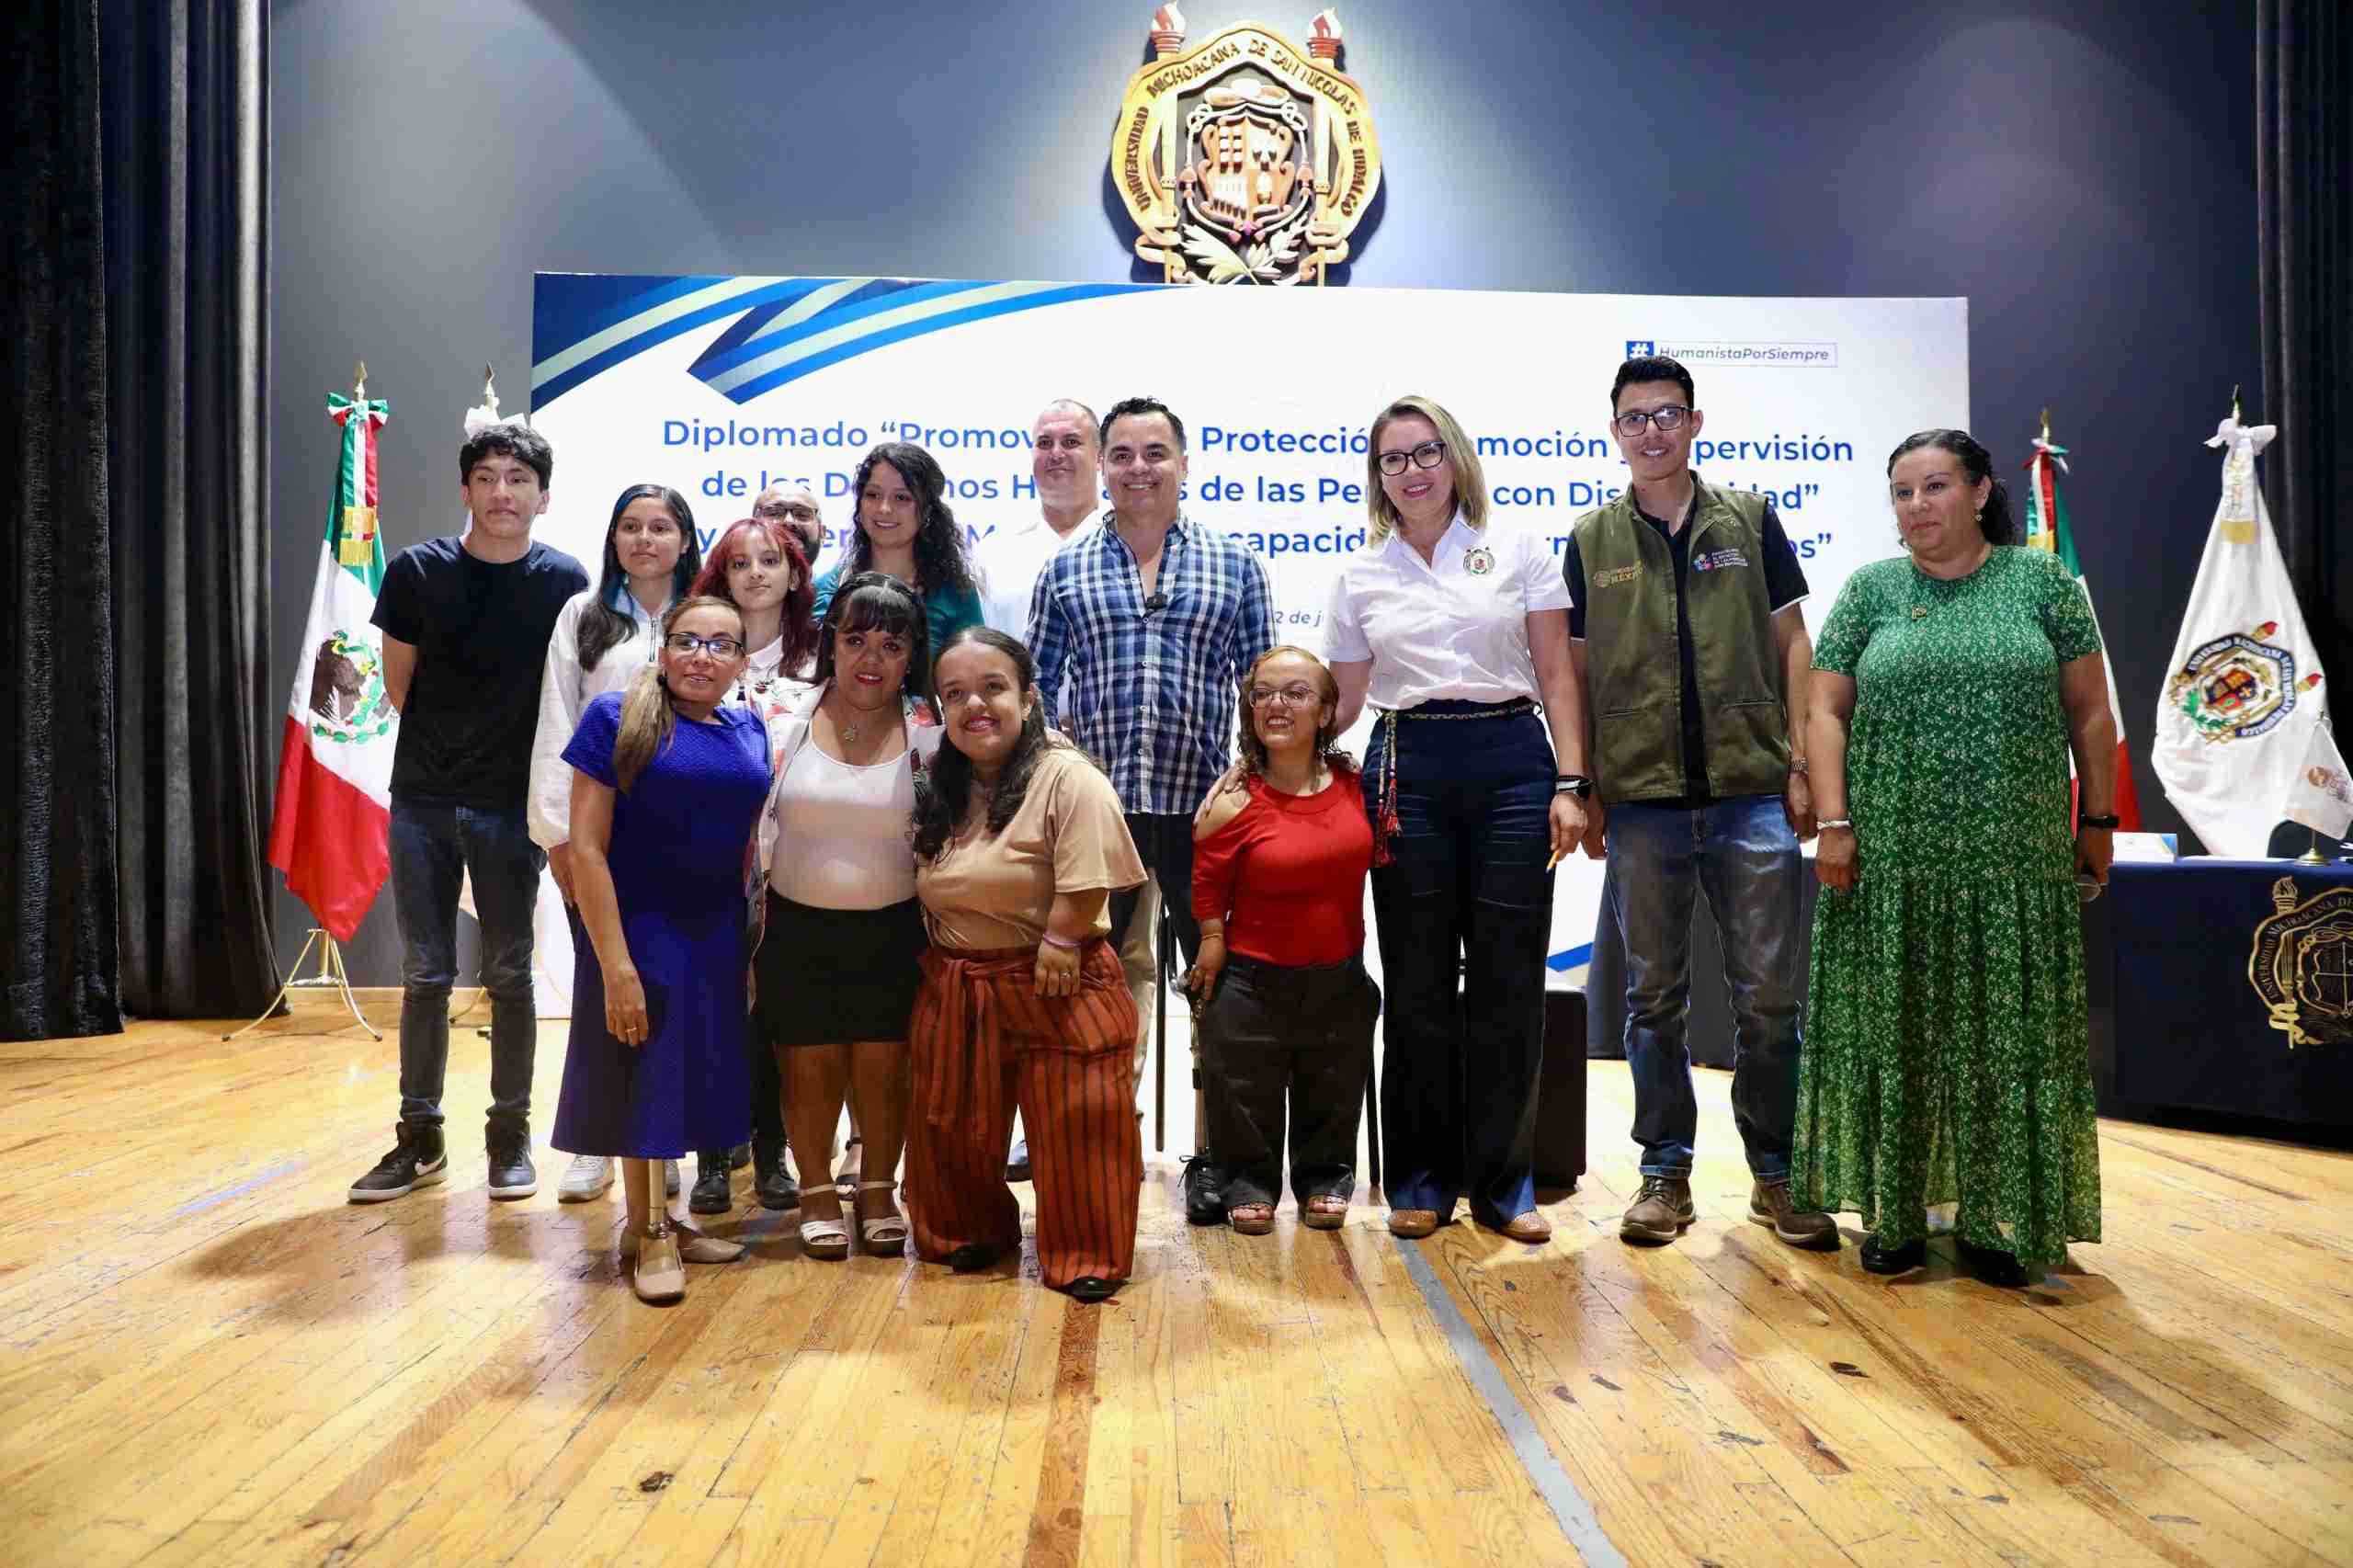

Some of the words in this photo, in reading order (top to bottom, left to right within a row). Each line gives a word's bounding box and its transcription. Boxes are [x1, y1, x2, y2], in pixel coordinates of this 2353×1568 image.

[1145, 40, 1242, 98] MICHOACANA
[1247, 38, 1267, 57] DE
[1270, 50, 1301, 77] SAN
[1346, 119, 1363, 143] DE
[664, 418, 868, 452] Diplomado
[881, 421, 1033, 449] “Promov
[1201, 426, 1368, 454] Protecció
[1477, 430, 1608, 458] moción
[1695, 434, 1853, 466] pervisión
[701, 470, 747, 497] de
[1200, 474, 1245, 502] de
[1257, 476, 1305, 504] las
[1493, 485, 1555, 506] con
[1289, 610, 1312, 624] de
